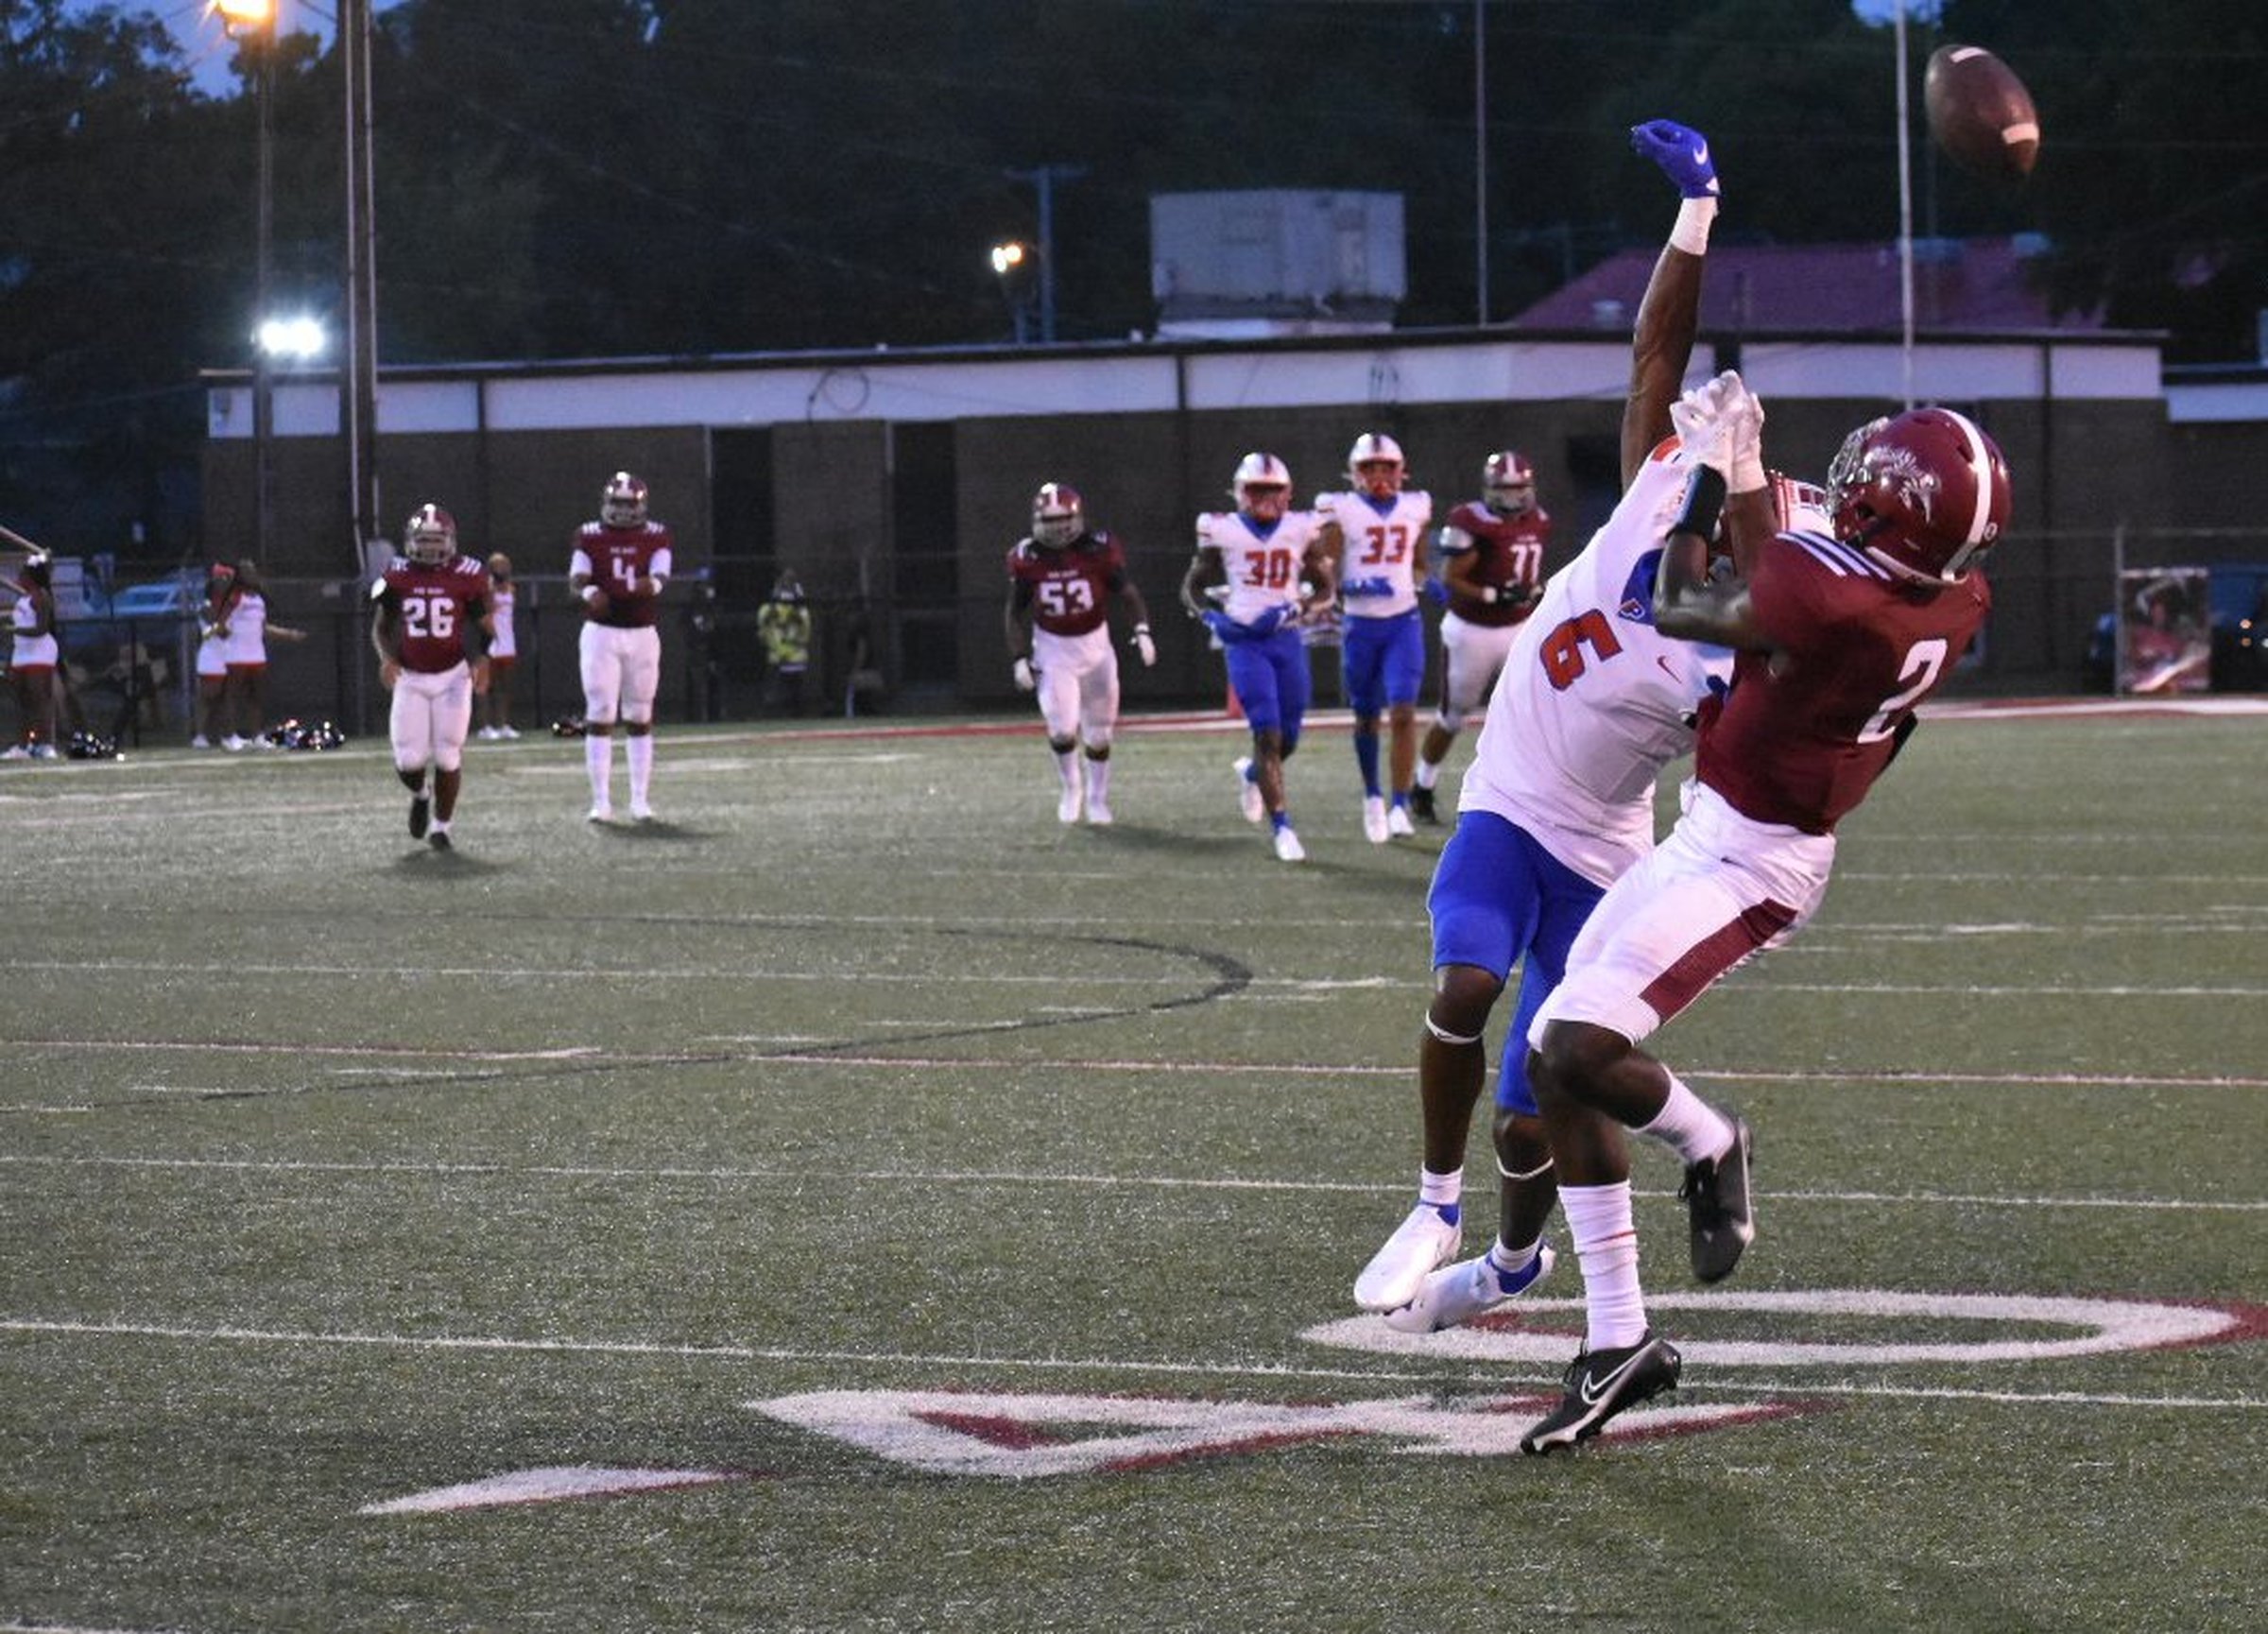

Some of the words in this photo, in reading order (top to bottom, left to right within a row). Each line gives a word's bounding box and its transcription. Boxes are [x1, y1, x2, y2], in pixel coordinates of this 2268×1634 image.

[1361, 525, 1407, 564] 33
[1510, 543, 1542, 585] 77
[612, 557, 637, 593] 4
[1244, 548, 1291, 588] 30
[403, 596, 455, 638] 26
[1039, 578, 1094, 616] 53
[1539, 608, 1624, 692] 6
[1857, 639, 1948, 744] 2
